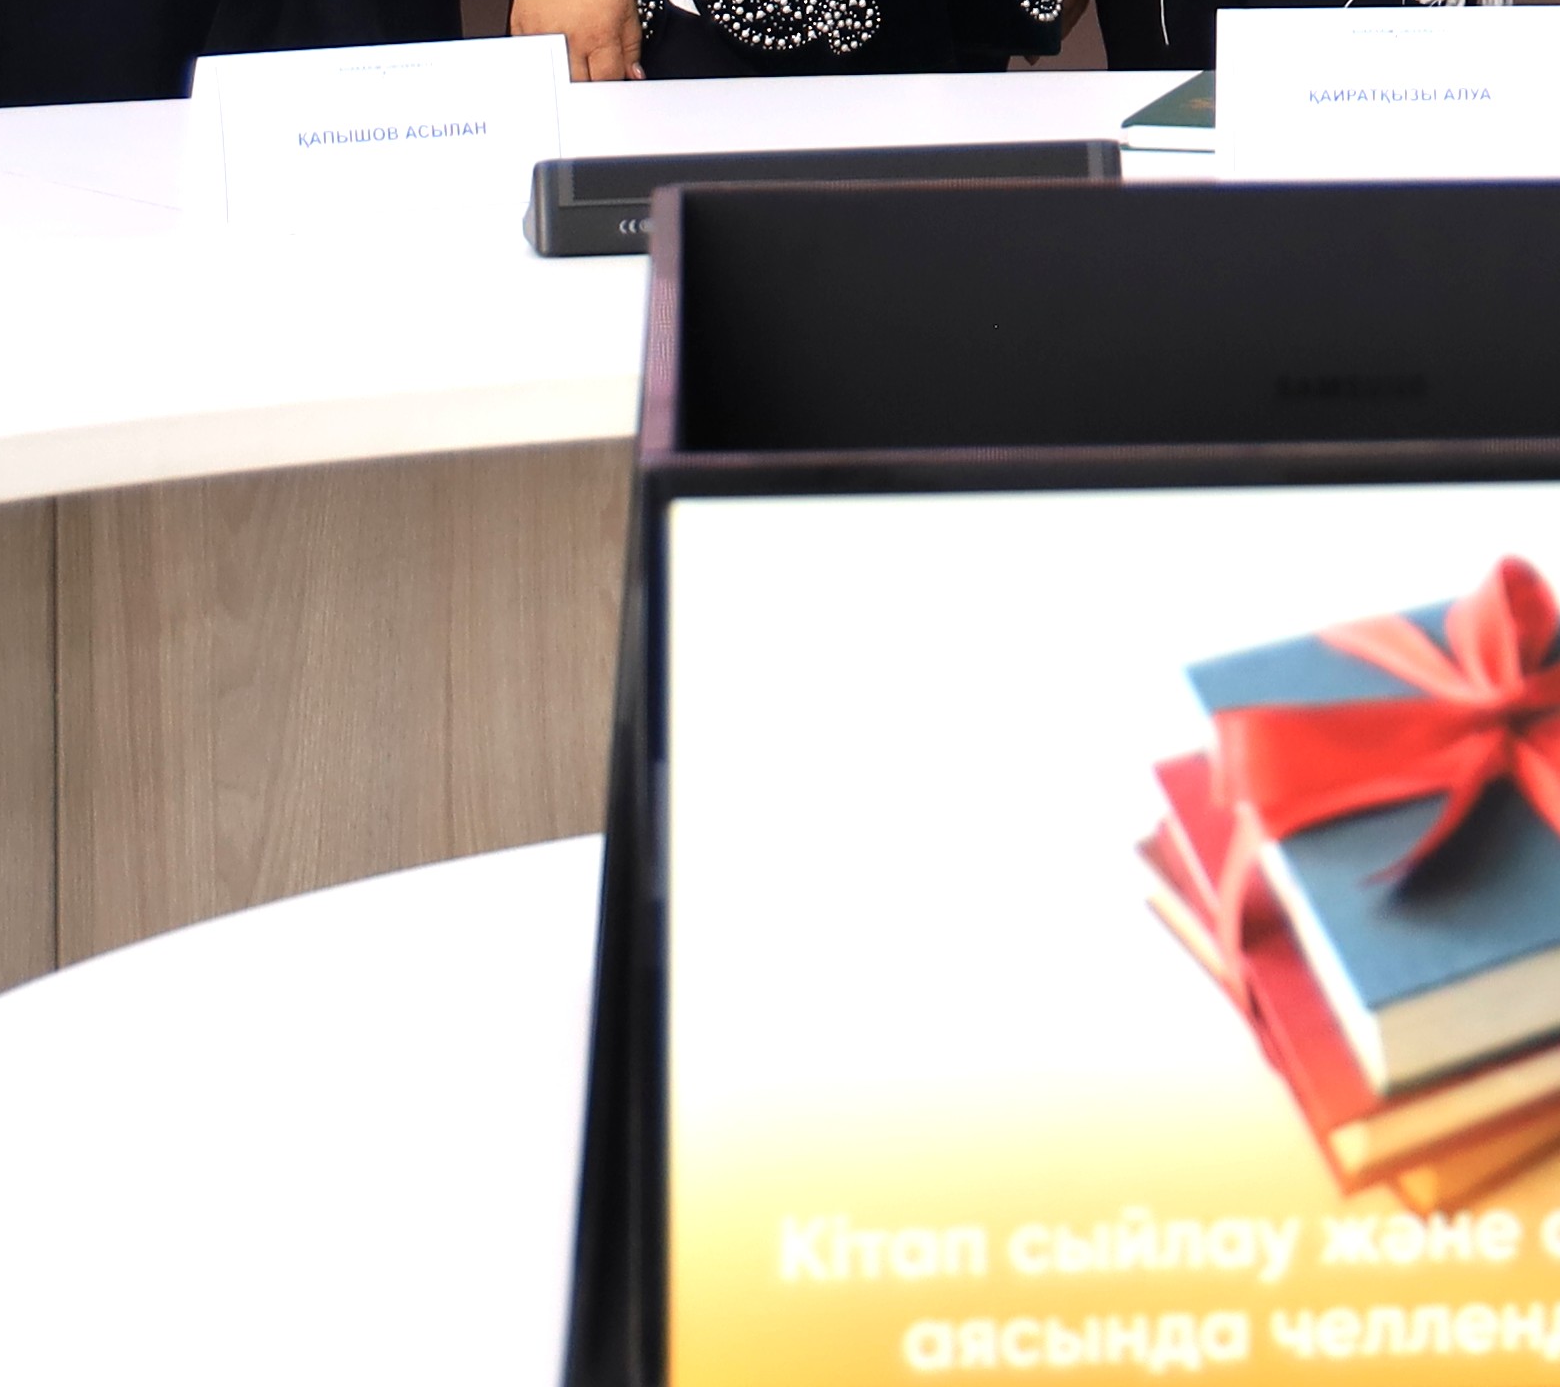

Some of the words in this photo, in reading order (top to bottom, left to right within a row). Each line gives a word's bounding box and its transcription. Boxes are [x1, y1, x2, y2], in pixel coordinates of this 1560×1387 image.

[1444, 88, 1492, 101] АЛУА
[298, 127, 399, 148] ҚАПЫШОВ
[405, 121, 487, 139] АСЫЛАН
[777, 1213, 988, 1282] Кітап
[1006, 1206, 1299, 1284] сыйлау
[1320, 1208, 1523, 1265] және
[902, 1308, 1252, 1373] аясында
